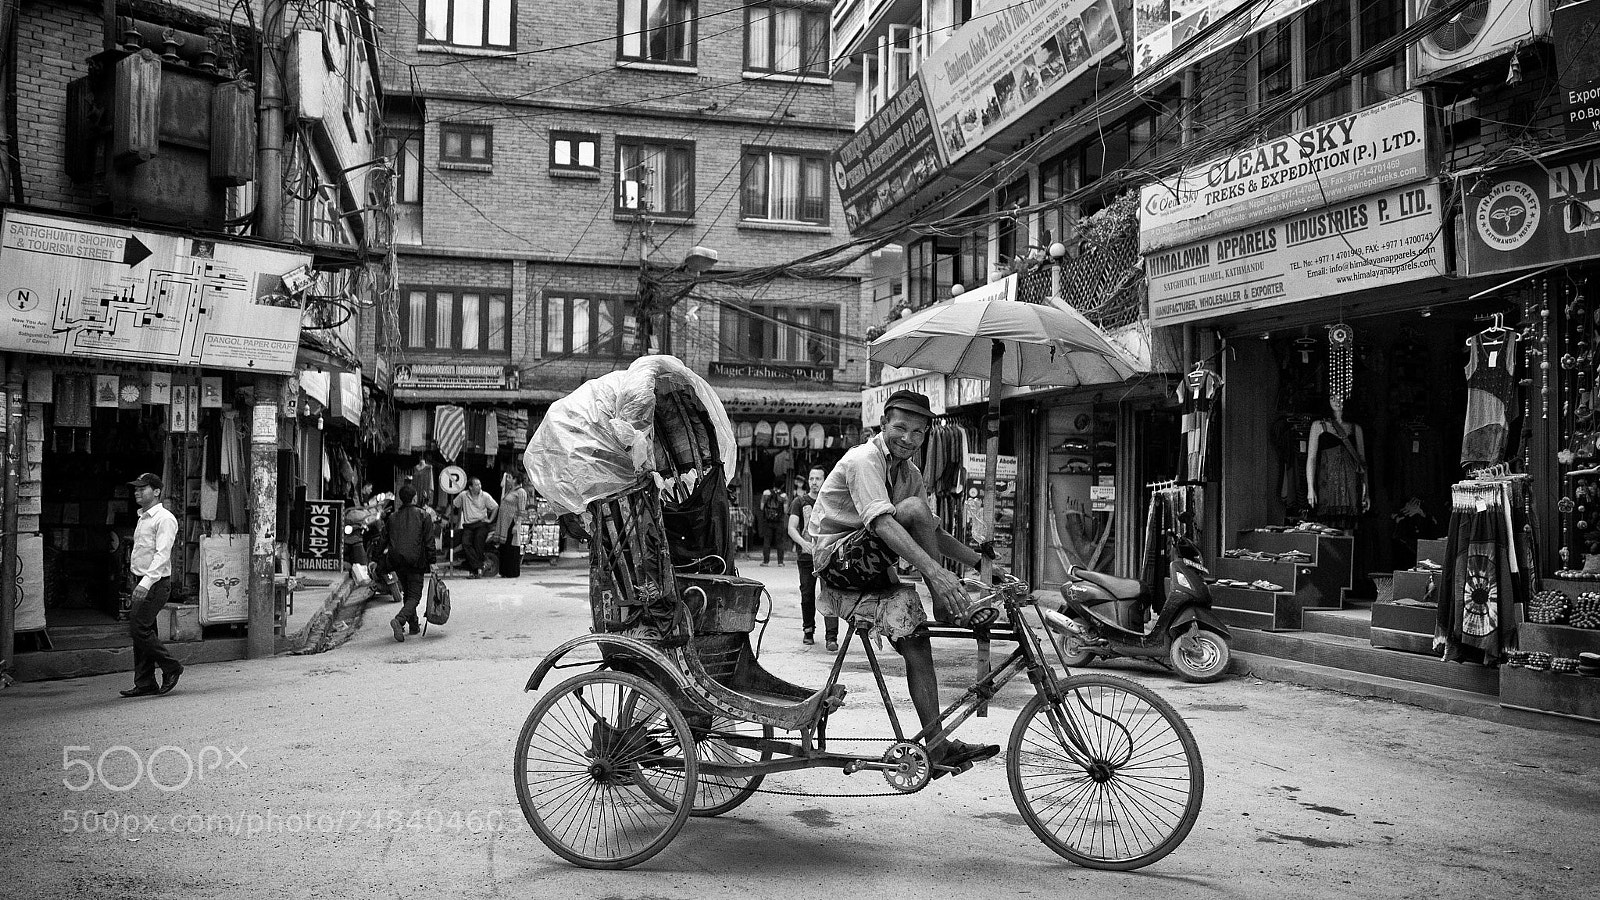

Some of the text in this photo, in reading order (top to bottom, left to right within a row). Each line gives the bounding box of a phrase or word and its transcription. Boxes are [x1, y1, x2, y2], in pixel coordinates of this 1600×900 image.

[969, 31, 988, 65] Abode
[839, 79, 923, 167] UNIQUE WAYMAKER
[1208, 115, 1357, 188] CLEAR SKY
[848, 166, 866, 189] TREKS
[1204, 130, 1421, 206] TREKS & EXPEDITION (P.) LTD.
[1330, 177, 1345, 186] Fax:
[1347, 159, 1400, 182] 977-1-4701469
[1325, 167, 1417, 198] www.viewnepaltreks.com
[1479, 184, 1537, 221] DYNAMIC CRAFT
[10, 224, 123, 249] SATHGHUMTI SHOPING
[1150, 189, 1432, 277] HIMALAYAN APPARELS INDUSTRIES P. LTD.
[1485, 220, 1534, 245] KATHMANDU, NEPAL
[17, 238, 114, 260] & TOURISM STREET
[1306, 245, 1436, 279] Email: info@himalayanapparels.com
[1314, 254, 1331, 266] +977
[1365, 243, 1380, 254] FAX:
[1381, 239, 1397, 251] +977
[1404, 232, 1434, 246] 4700743
[1199, 272, 1225, 284] THAMEL,
[1225, 261, 1265, 278] KATHMANDU
[1335, 257, 1437, 285] www.himalayanapparels.com
[18, 290, 29, 301] N
[1155, 282, 1284, 317] MANUFACTURER, WHOLESALLER & EXPORTER
[207, 335, 242, 346] DANGOL
[243, 339, 270, 349] PAPER
[270, 342, 296, 351] CRAFT
[714, 364, 745, 378] Magic
[810, 369, 826, 381] Ltd
[449, 473, 460, 489] P
[309, 504, 331, 558] MONEY
[297, 558, 339, 570] CHANGER
